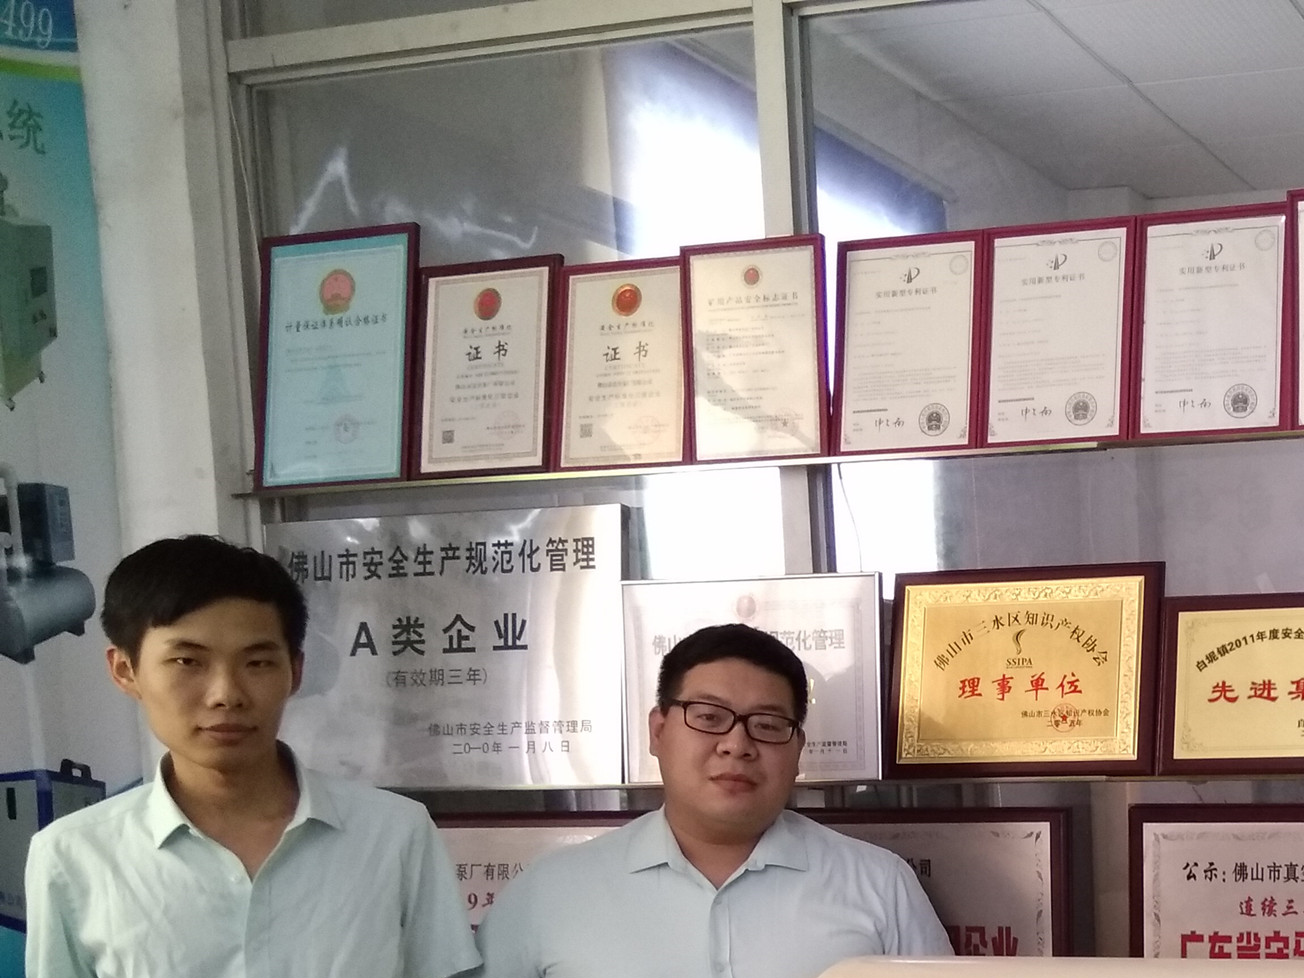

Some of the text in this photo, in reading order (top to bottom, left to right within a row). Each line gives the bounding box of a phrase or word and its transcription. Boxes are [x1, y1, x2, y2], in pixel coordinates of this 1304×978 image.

[0, 99, 45, 155] 统
[465, 340, 509, 362] 证书
[602, 340, 650, 363] 证书
[288, 536, 597, 584] 佛山市安全生产规范化管理
[350, 612, 529, 657] A类企业
[934, 610, 1110, 672] 佛山市三水区知识产权协会
[1006, 657, 1033, 666] SSIPA
[957, 671, 1083, 701] 理事单位
[427, 719, 593, 737] 佛山市安全生产监督管理局
